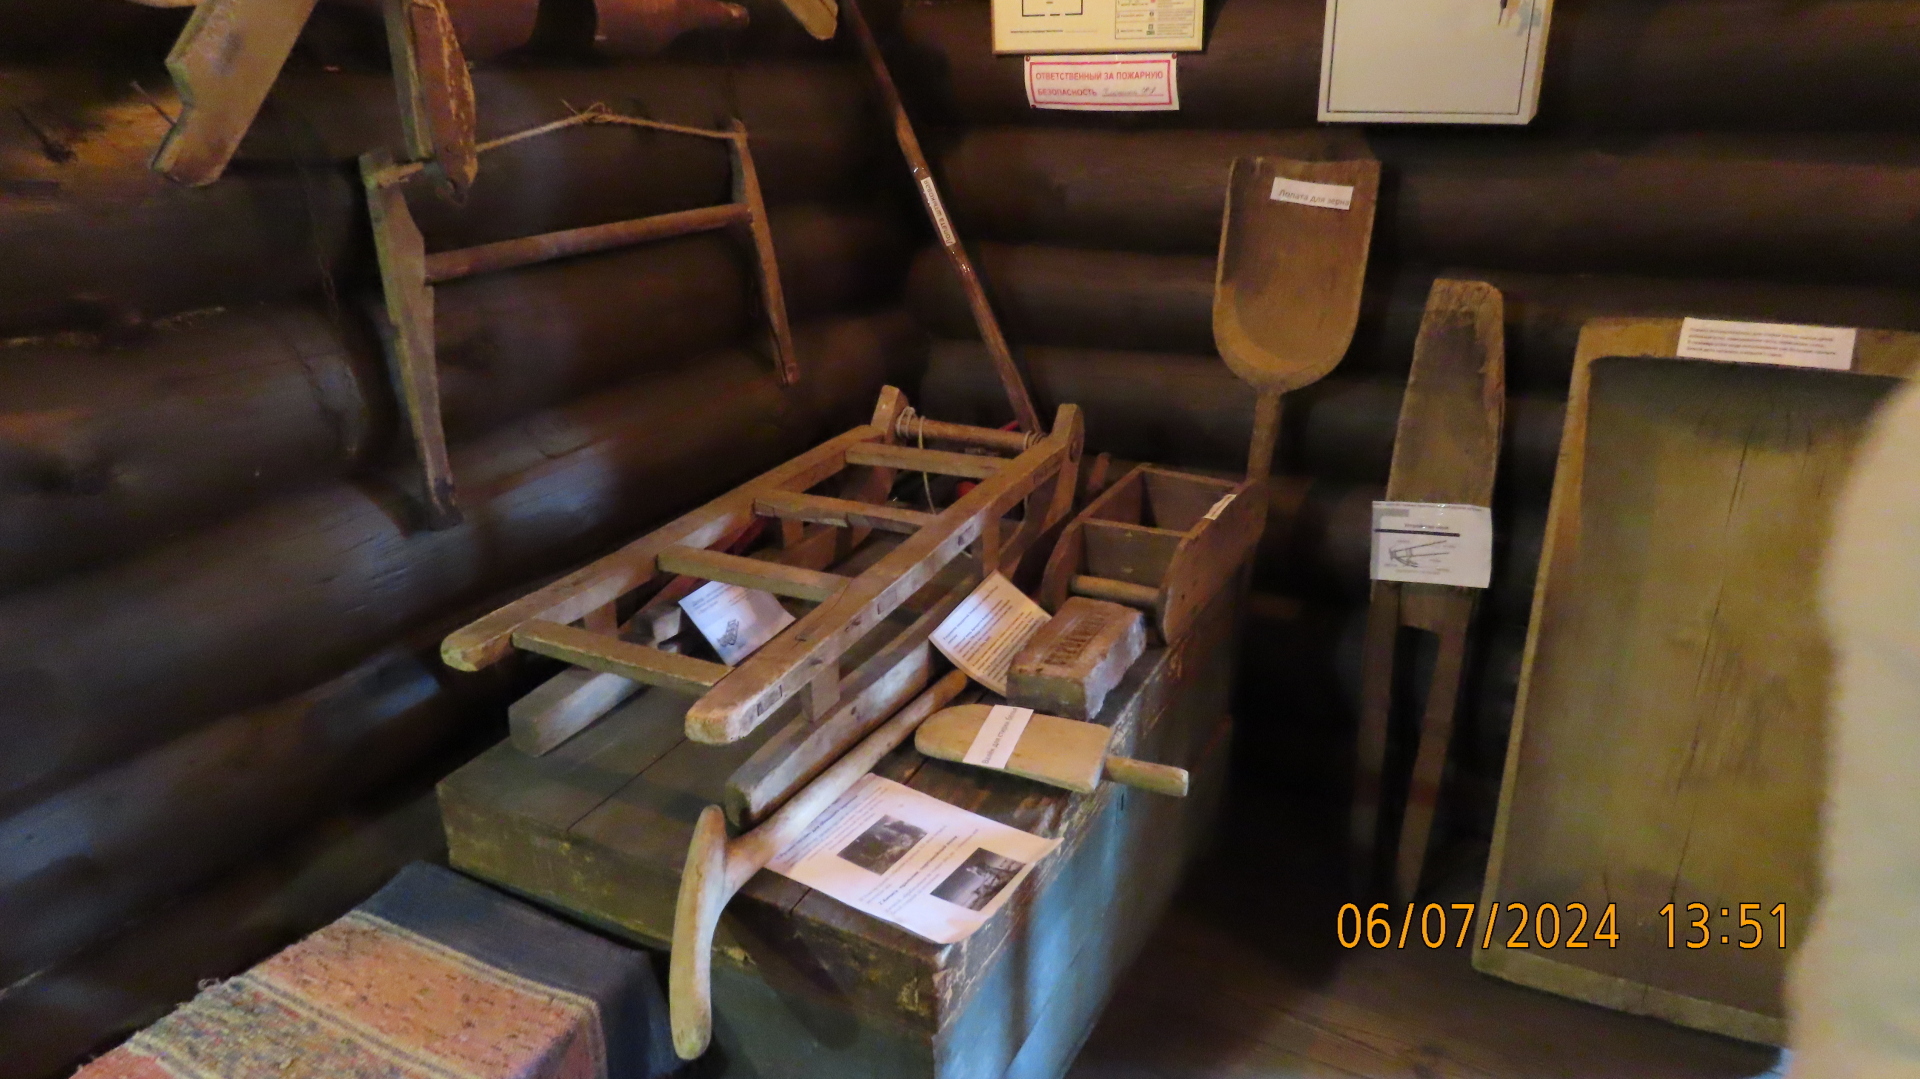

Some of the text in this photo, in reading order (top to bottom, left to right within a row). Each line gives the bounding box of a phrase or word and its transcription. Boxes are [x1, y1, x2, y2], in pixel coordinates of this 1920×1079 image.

[1035, 70, 1163, 81] ОТВЕТСТВЕННЫЙ ЗА ПОЖАРНУЮ
[1037, 88, 1097, 97] БЕЗОПАСНОСТЬ
[1279, 189, 1308, 201] Лопата
[1310, 195, 1325, 203] для
